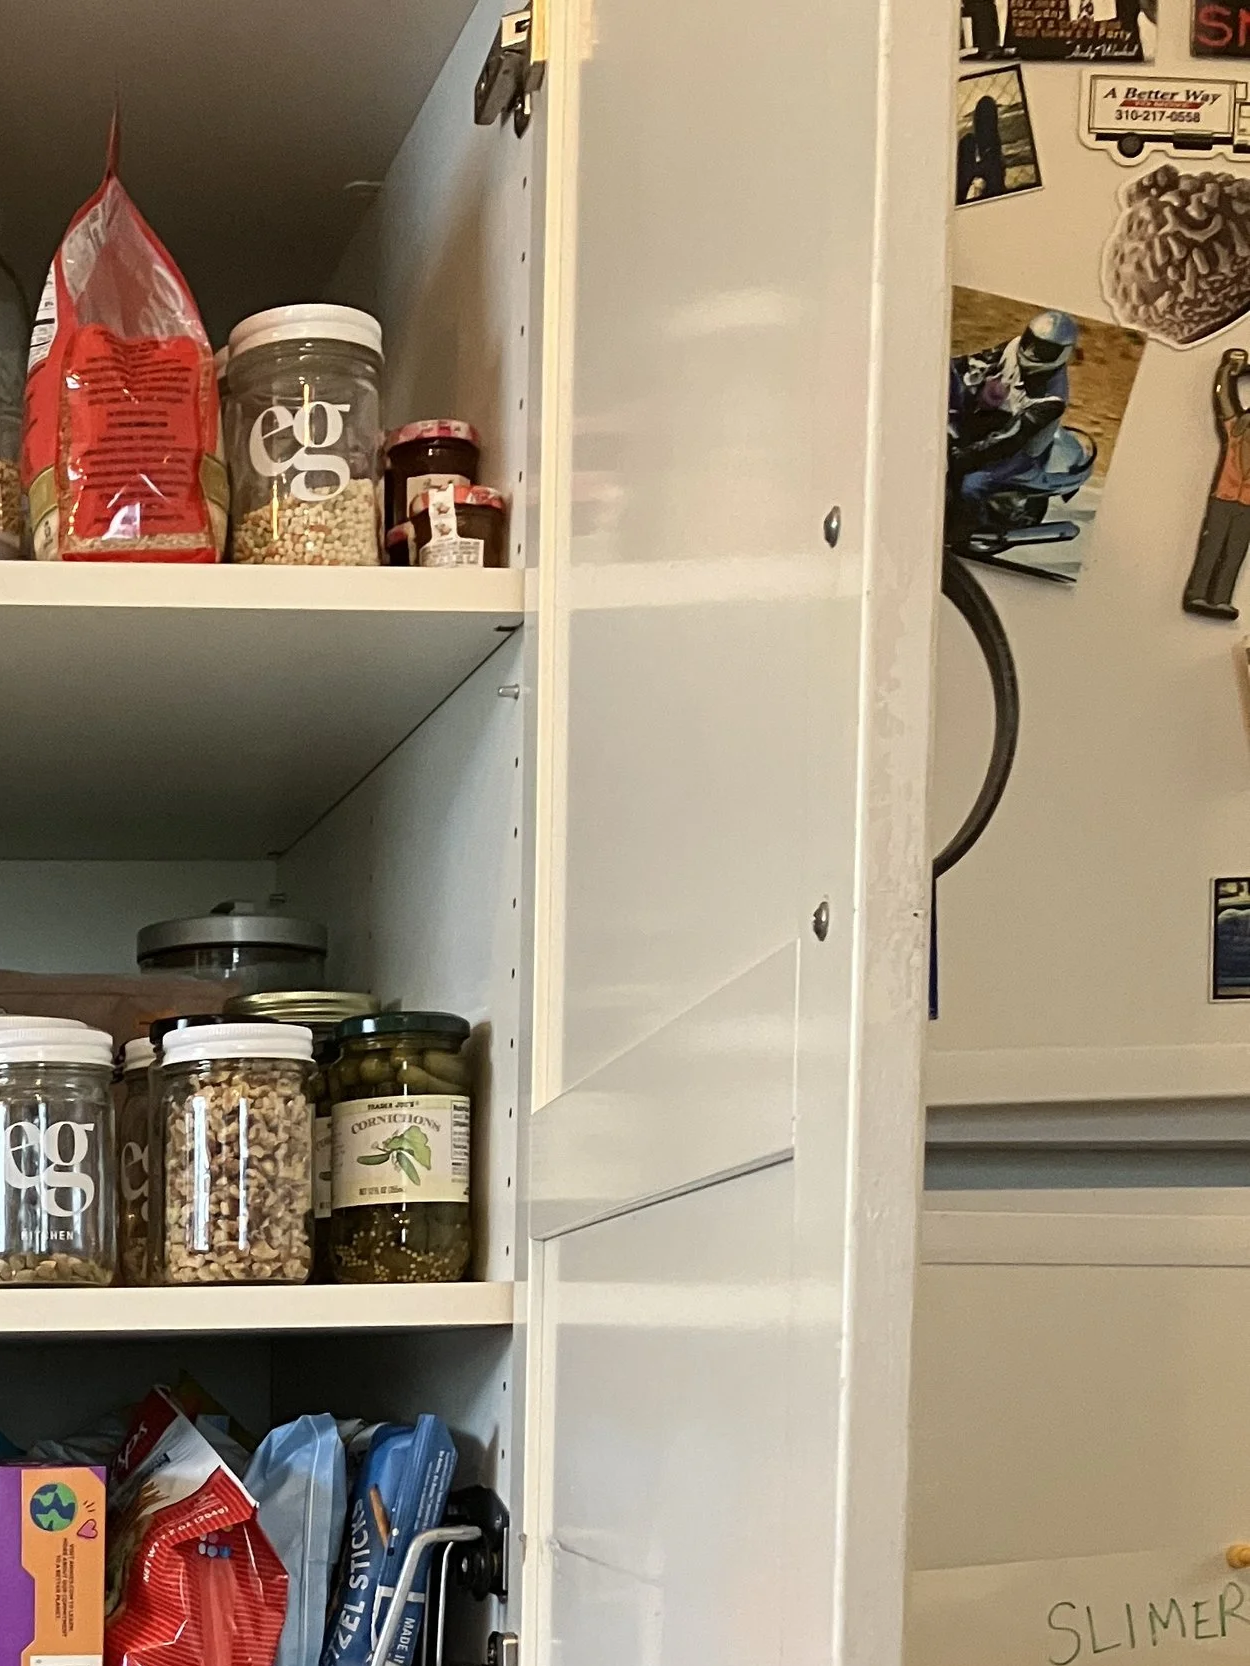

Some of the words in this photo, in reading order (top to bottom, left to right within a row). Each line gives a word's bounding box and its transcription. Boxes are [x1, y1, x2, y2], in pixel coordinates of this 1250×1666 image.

[1103, 87, 1117, 99] A
[1124, 87, 1180, 101] Better
[1185, 90, 1222, 106] Way
[1115, 109, 1201, 123] 310-217-0558
[249, 401, 350, 501] eg
[368, 1102, 393, 1111] TRADER
[351, 1113, 442, 1135] CORNICHONS
[4, 1121, 95, 1217] eg
[349, 1498, 371, 1590] STICKS
[396, 1617, 416, 1651] MADE
